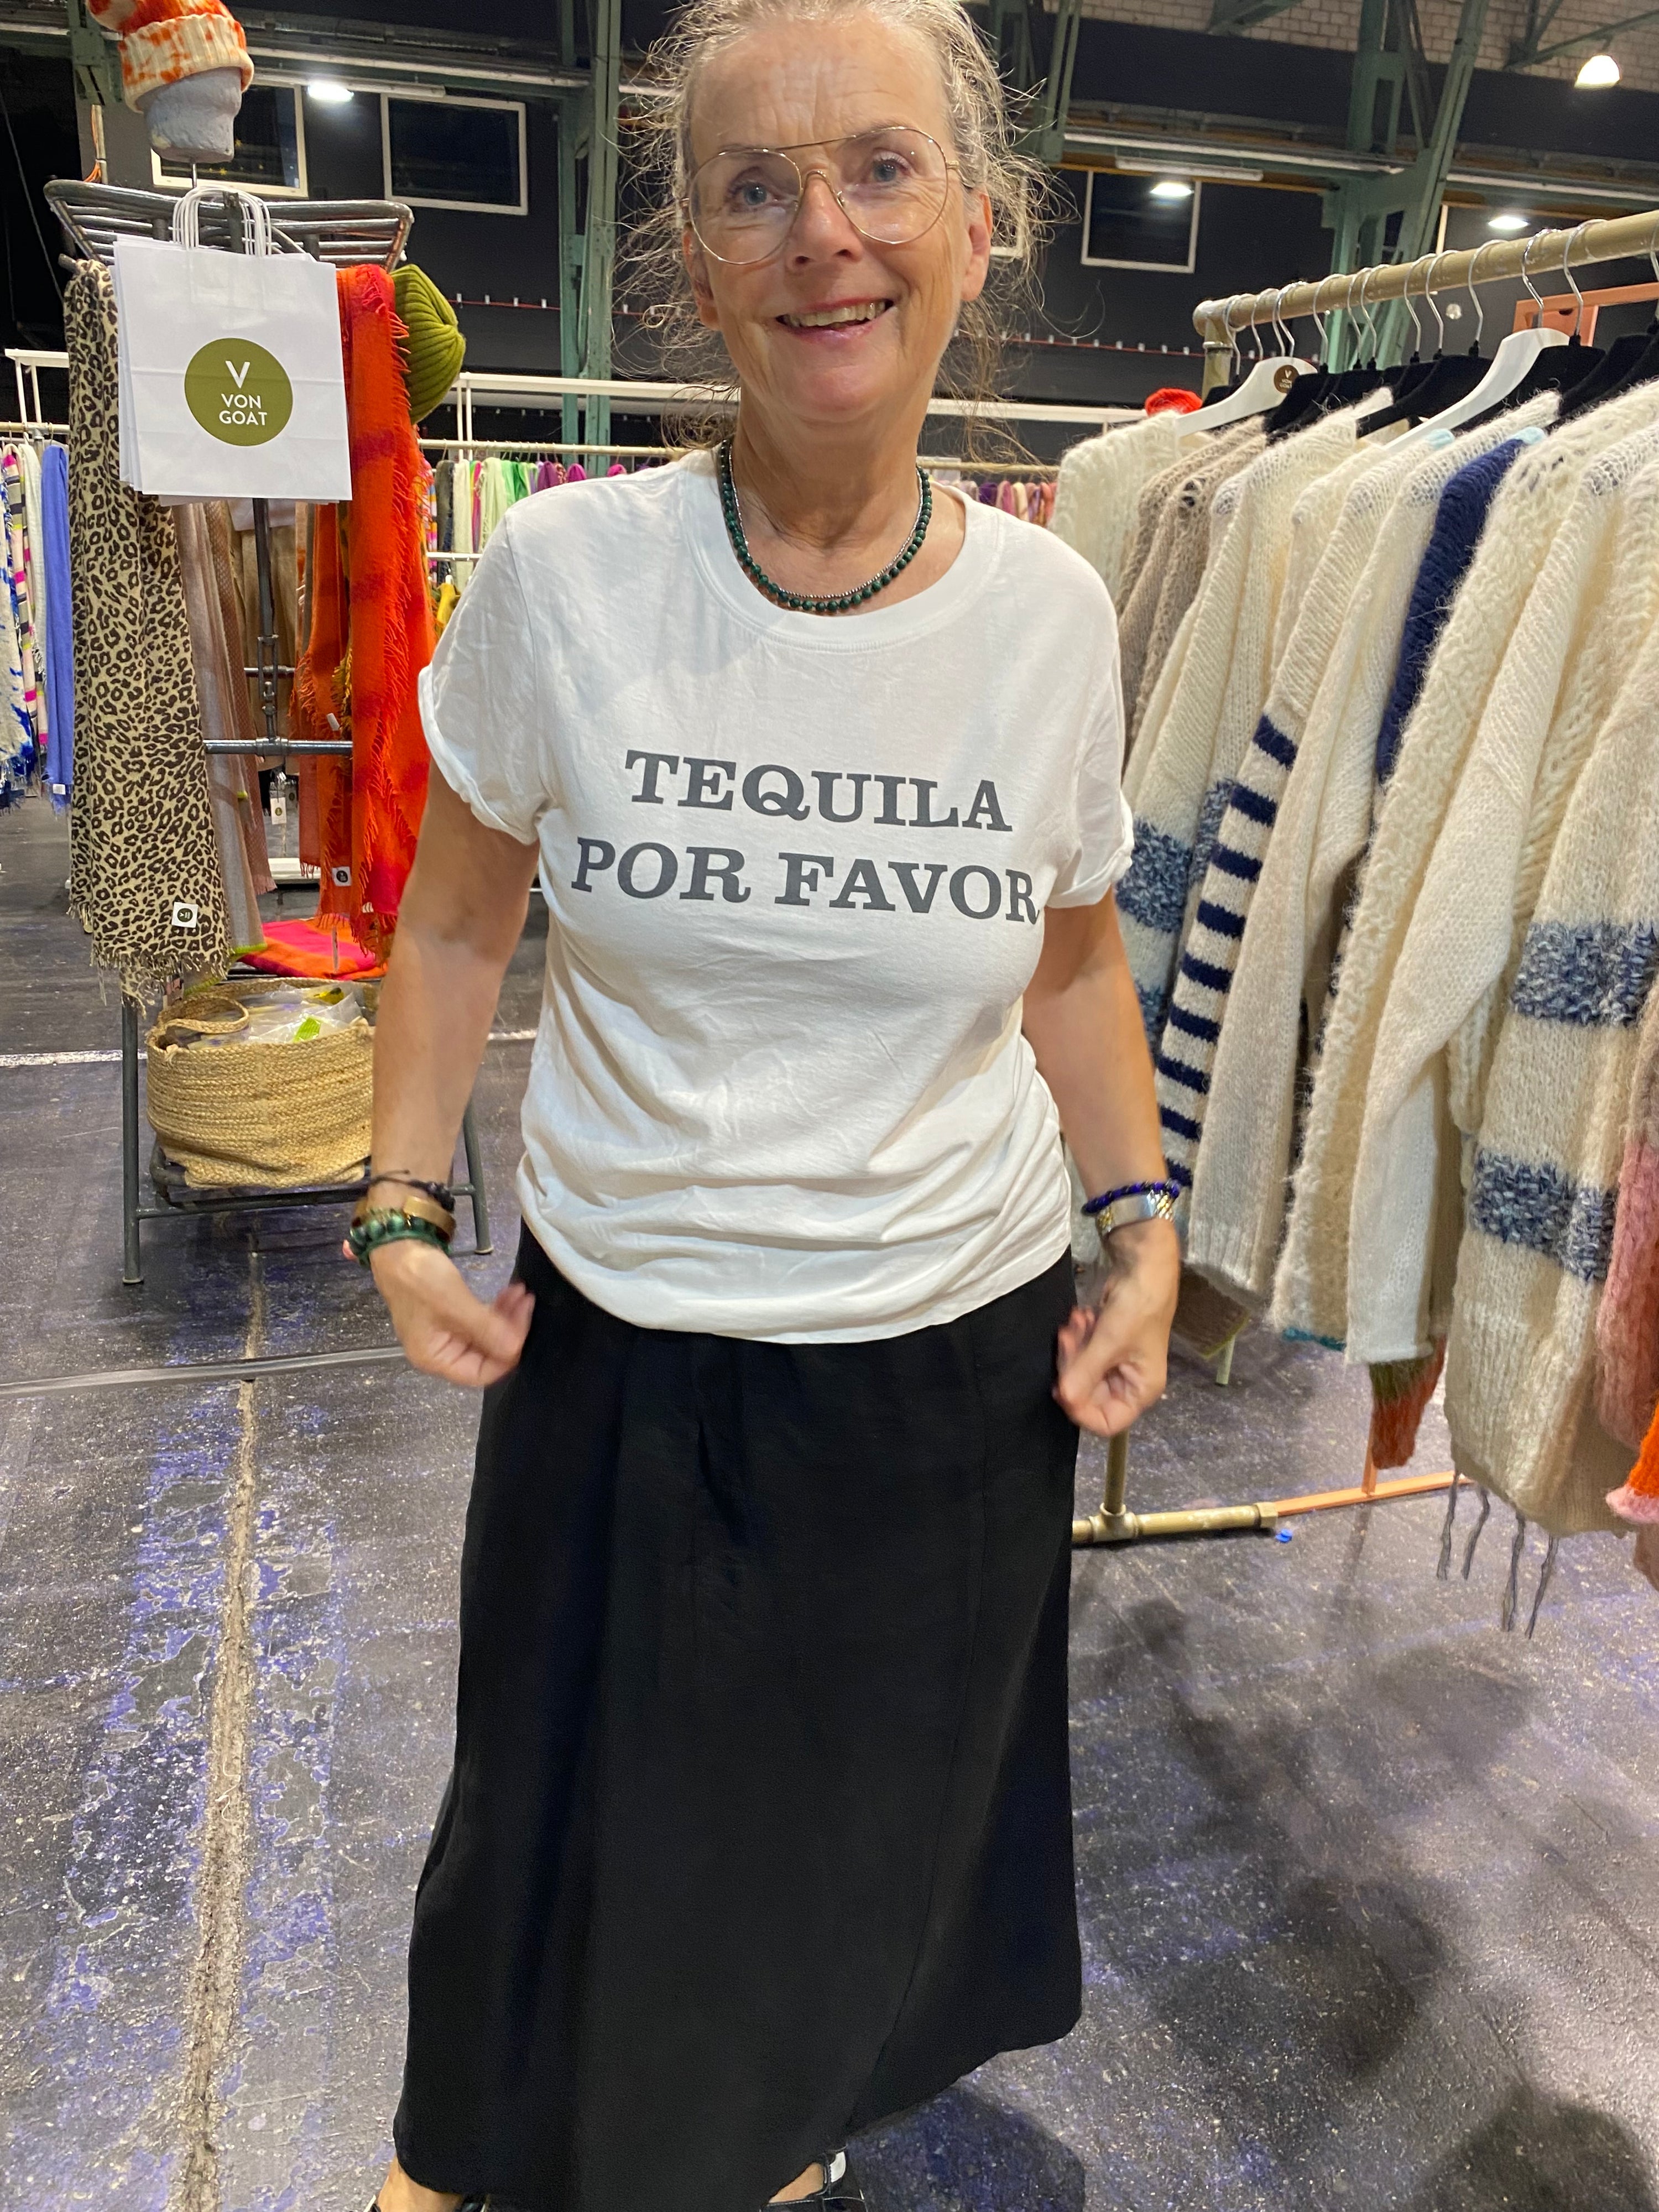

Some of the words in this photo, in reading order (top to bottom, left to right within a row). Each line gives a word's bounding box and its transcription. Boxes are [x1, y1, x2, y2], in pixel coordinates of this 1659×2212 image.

[225, 361, 251, 389] V
[221, 393, 262, 409] VON
[219, 410, 268, 426] GOAT
[625, 750, 1013, 832] TEQUILA
[571, 836, 751, 903] POR
[774, 852, 1040, 925] FAVOR
